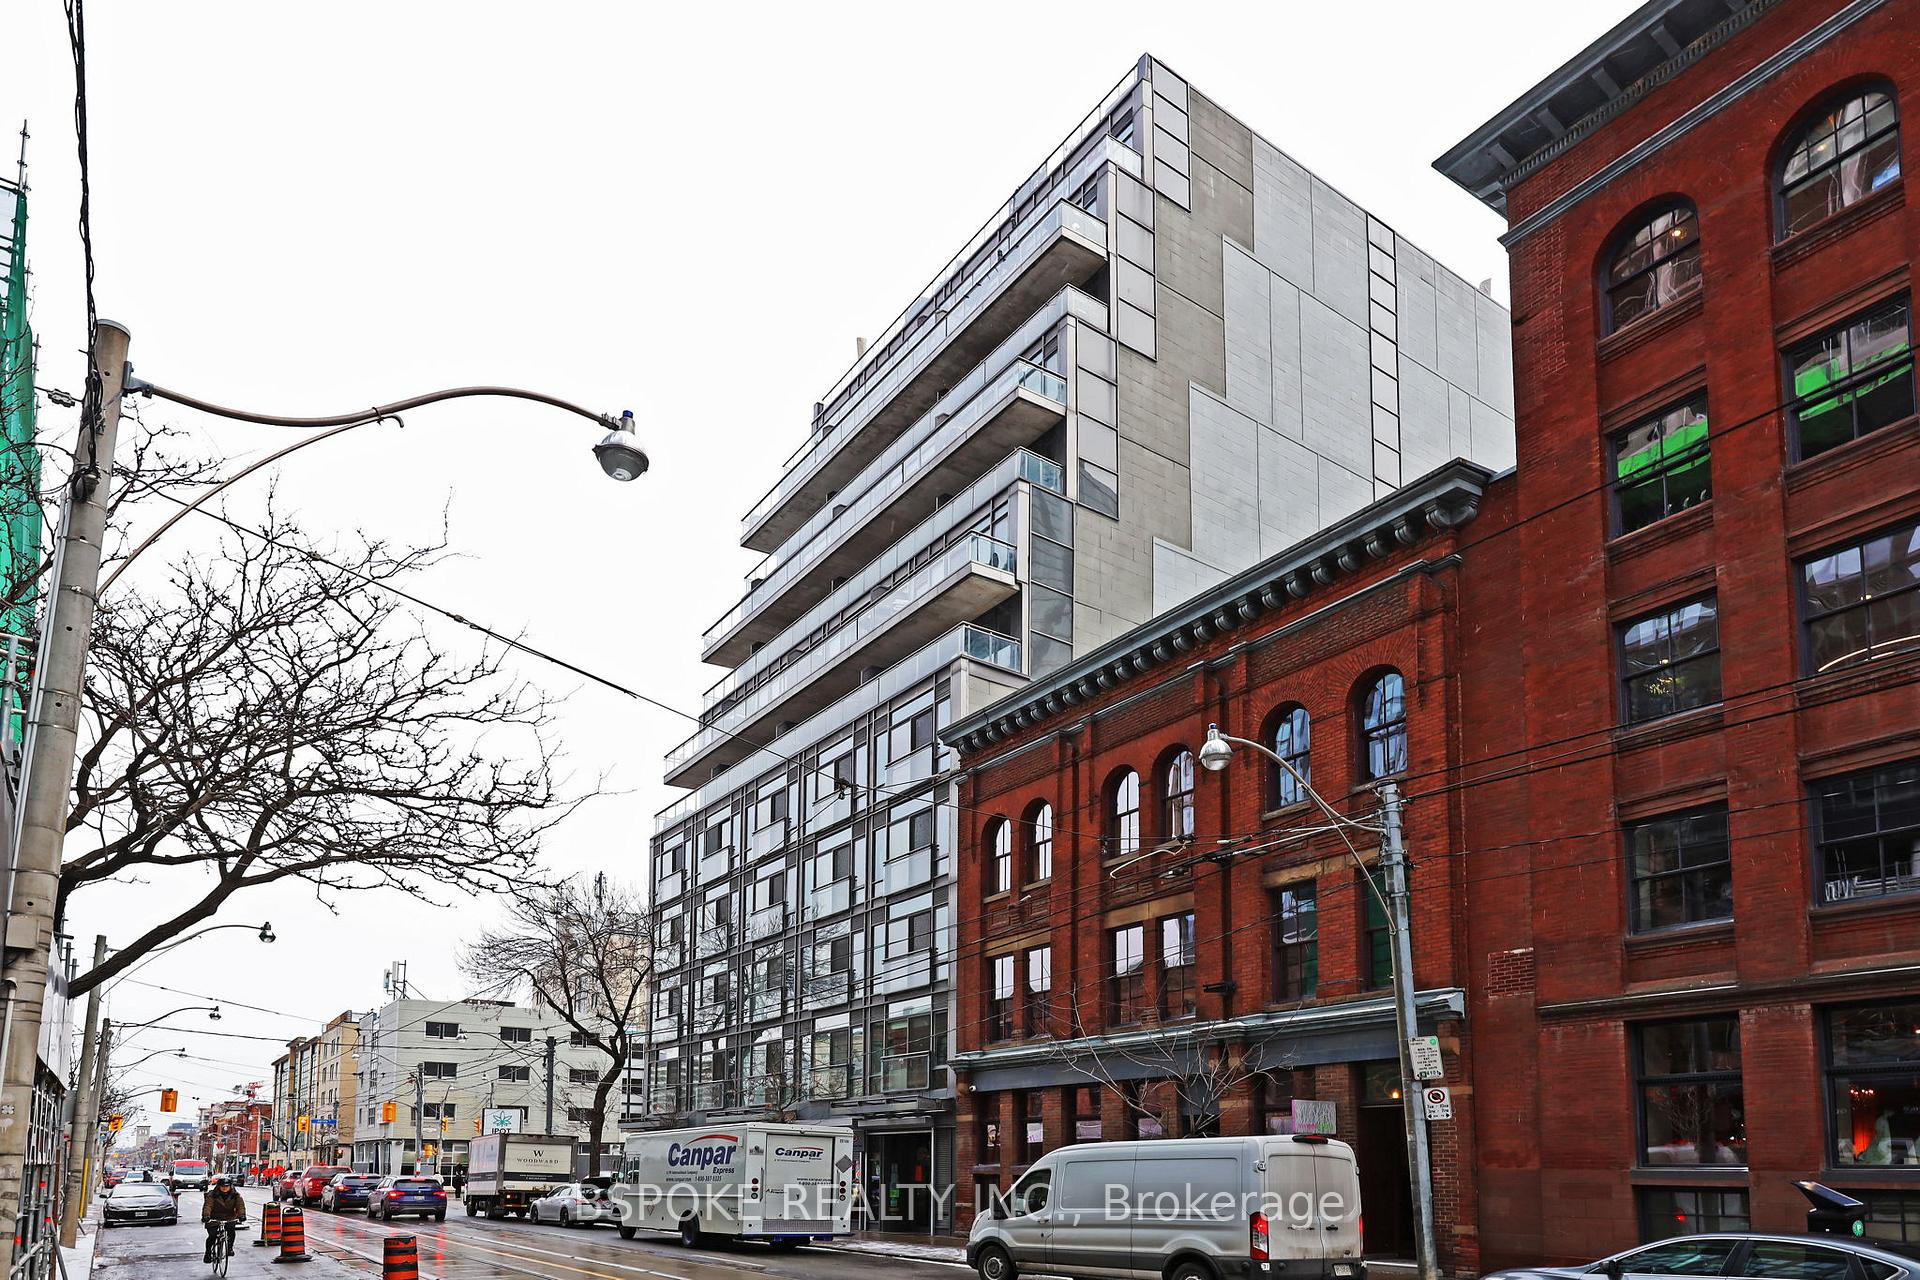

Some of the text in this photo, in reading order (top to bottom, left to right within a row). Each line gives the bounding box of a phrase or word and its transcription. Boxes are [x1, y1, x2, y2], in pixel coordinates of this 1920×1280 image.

[668, 1142, 737, 1170] Canpar
[775, 1147, 824, 1159] Canpar
[712, 1166, 735, 1175] Express
